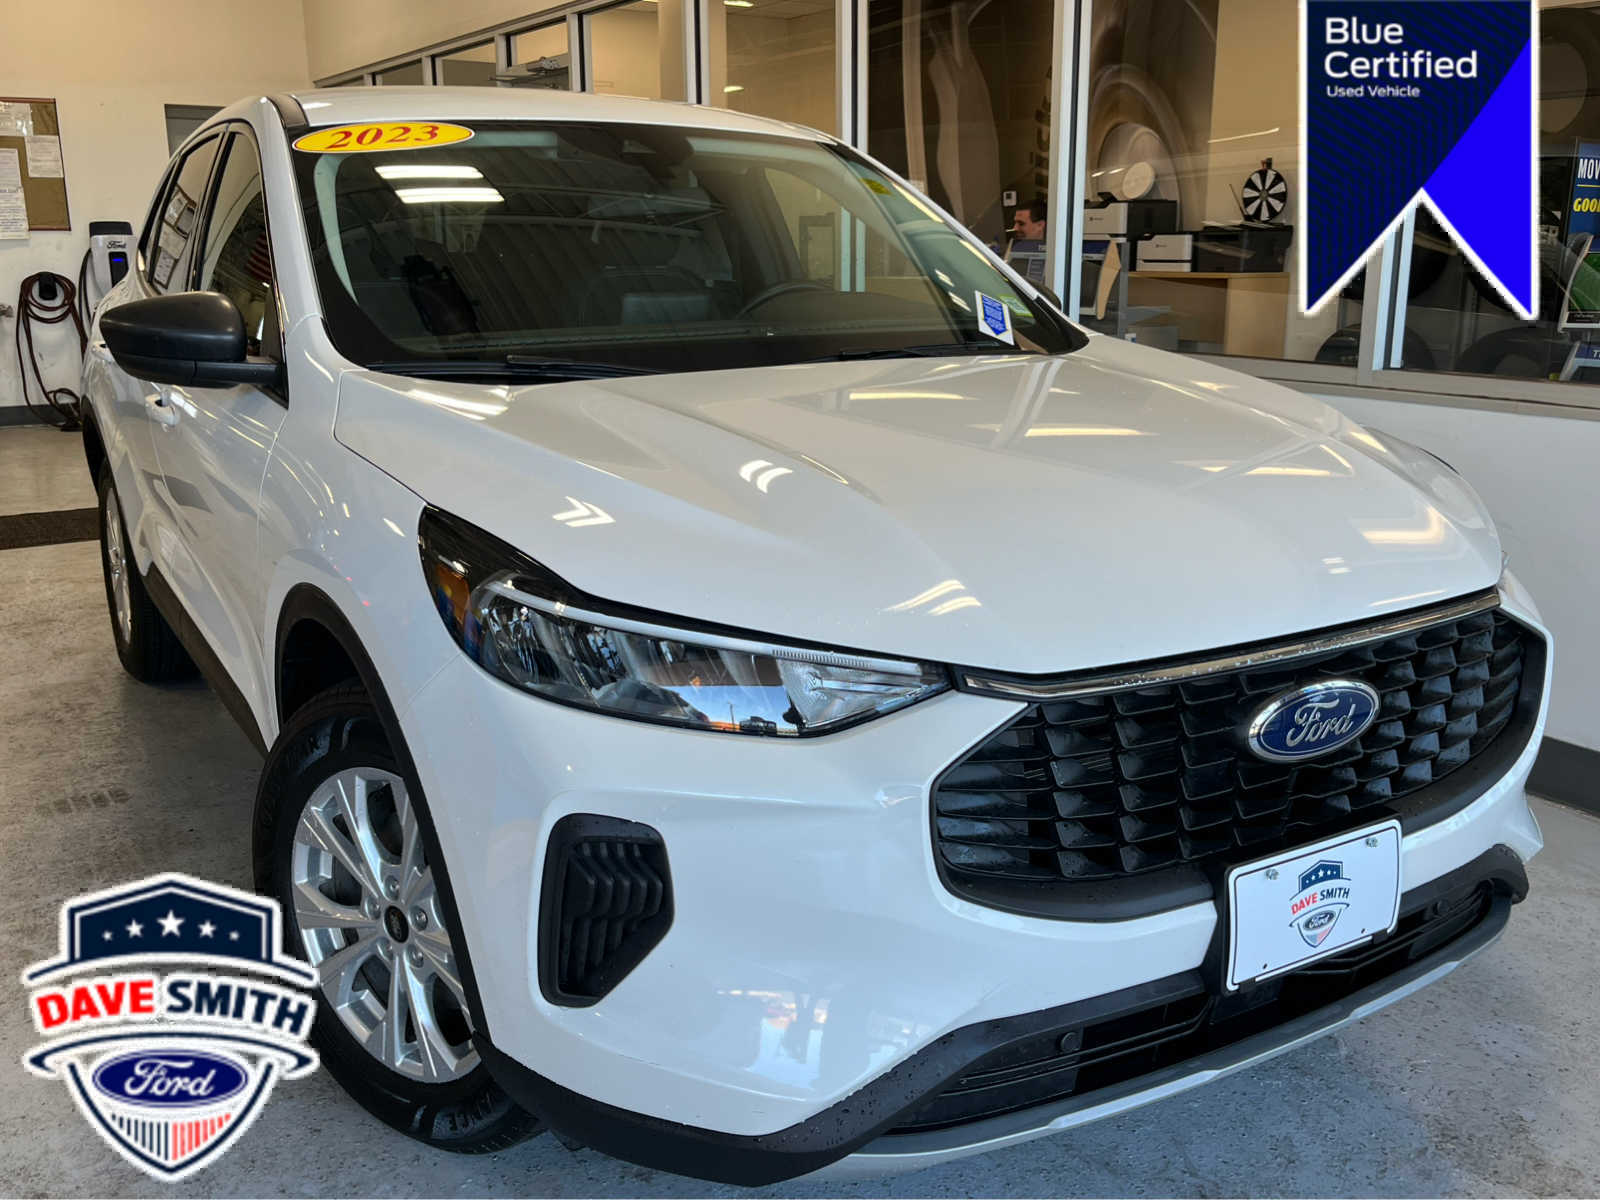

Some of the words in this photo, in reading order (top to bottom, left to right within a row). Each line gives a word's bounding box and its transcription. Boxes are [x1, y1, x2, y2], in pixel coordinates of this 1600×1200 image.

[325, 125, 441, 149] 2023
[1286, 698, 1356, 747] Ford
[1291, 892, 1318, 915] DAVE
[1319, 887, 1350, 901] SMITH
